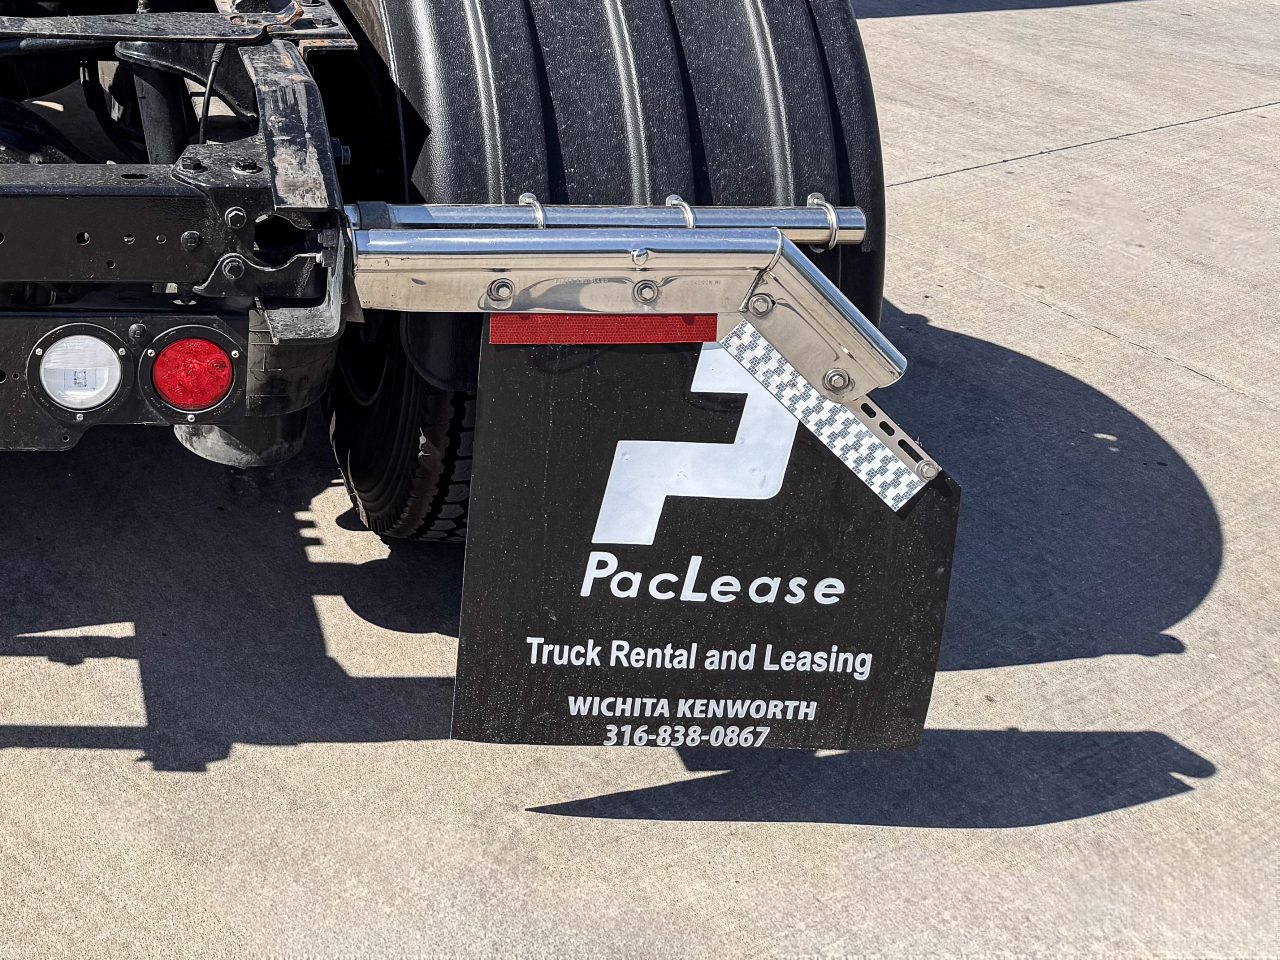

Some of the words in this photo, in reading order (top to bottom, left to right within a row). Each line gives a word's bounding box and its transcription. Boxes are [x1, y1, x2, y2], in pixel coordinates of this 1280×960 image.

[580, 552, 845, 605] PacLease
[526, 637, 601, 666] Truck
[610, 640, 697, 670] Rental
[705, 644, 756, 671] and
[763, 644, 872, 680] Leasing
[567, 696, 670, 718] WICHITA
[677, 698, 817, 720] KENWORTH
[603, 725, 771, 747] 316-838-0867
